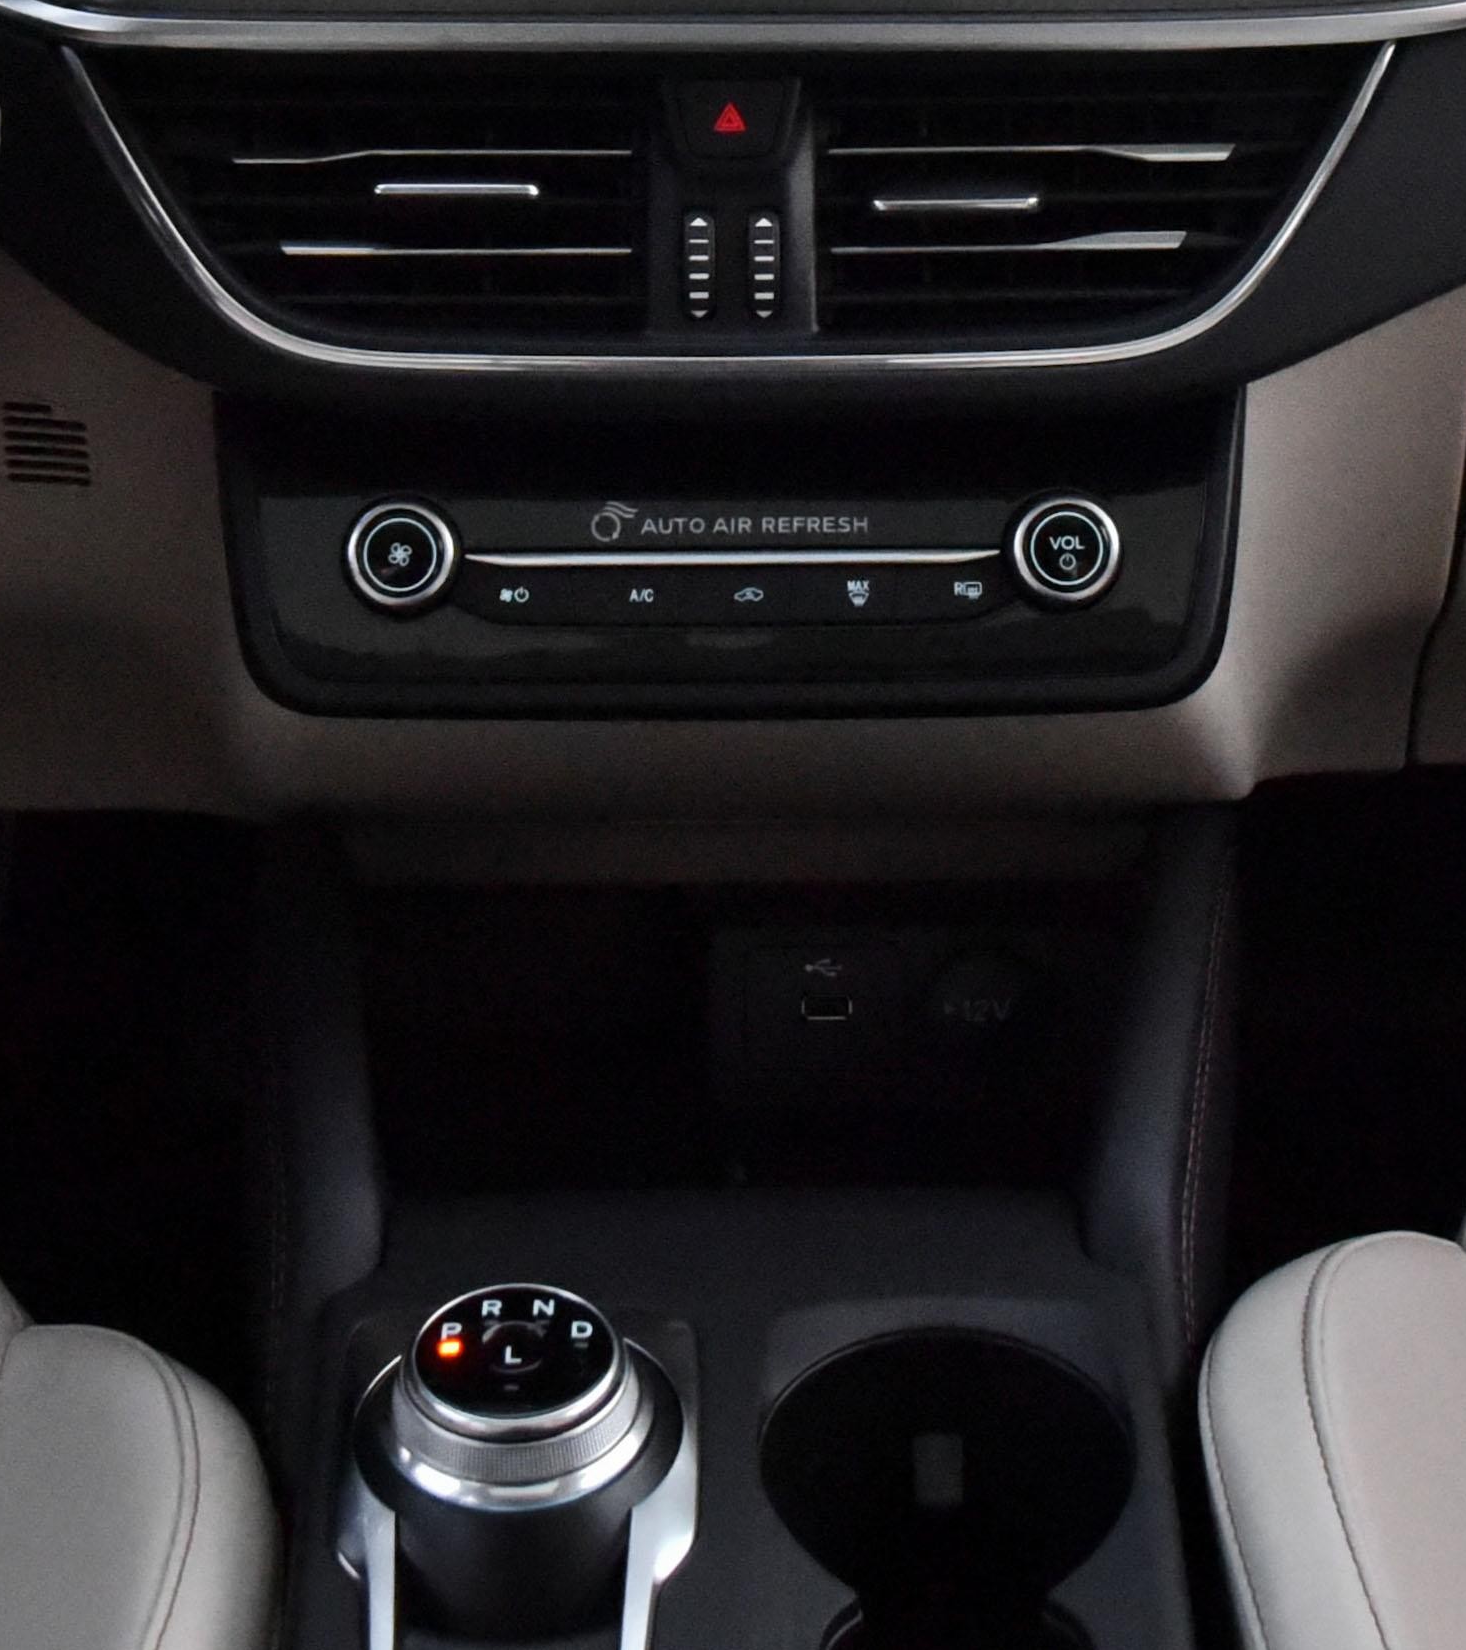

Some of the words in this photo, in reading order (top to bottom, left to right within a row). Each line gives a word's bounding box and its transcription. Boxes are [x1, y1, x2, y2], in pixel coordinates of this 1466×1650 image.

[640, 516, 705, 535] AUTO
[712, 516, 752, 534] AIR
[761, 516, 869, 534] REFRESH
[1049, 535, 1084, 551] VOL
[847, 580, 870, 592] MAX
[629, 587, 654, 603] A/C
[440, 1322, 463, 1342] P
[481, 1300, 503, 1317] R
[533, 1299, 555, 1317] N
[570, 1320, 593, 1339] D
[504, 1345, 522, 1364] L
